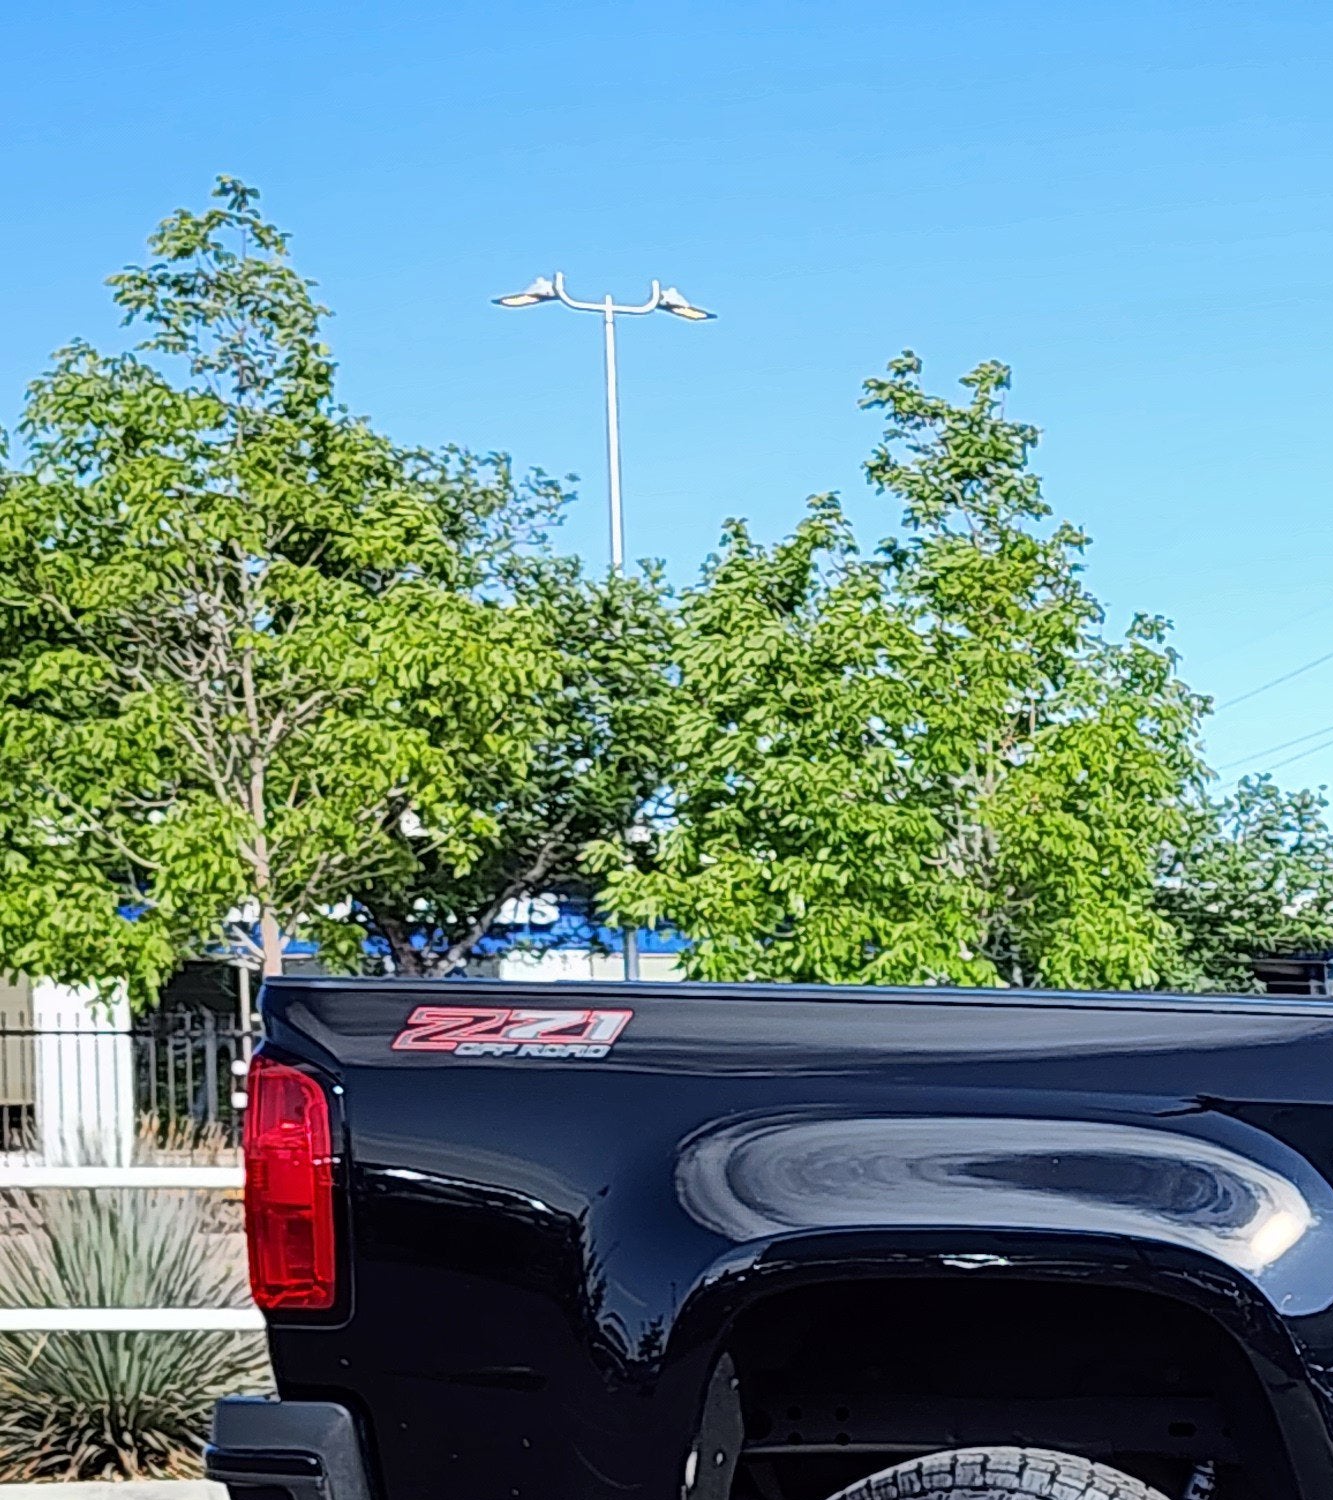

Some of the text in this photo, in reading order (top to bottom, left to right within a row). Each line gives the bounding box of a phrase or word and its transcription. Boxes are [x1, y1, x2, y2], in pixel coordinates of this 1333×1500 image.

[391, 1005, 634, 1051] Z71
[453, 1042, 613, 1059] OFF ROAD
